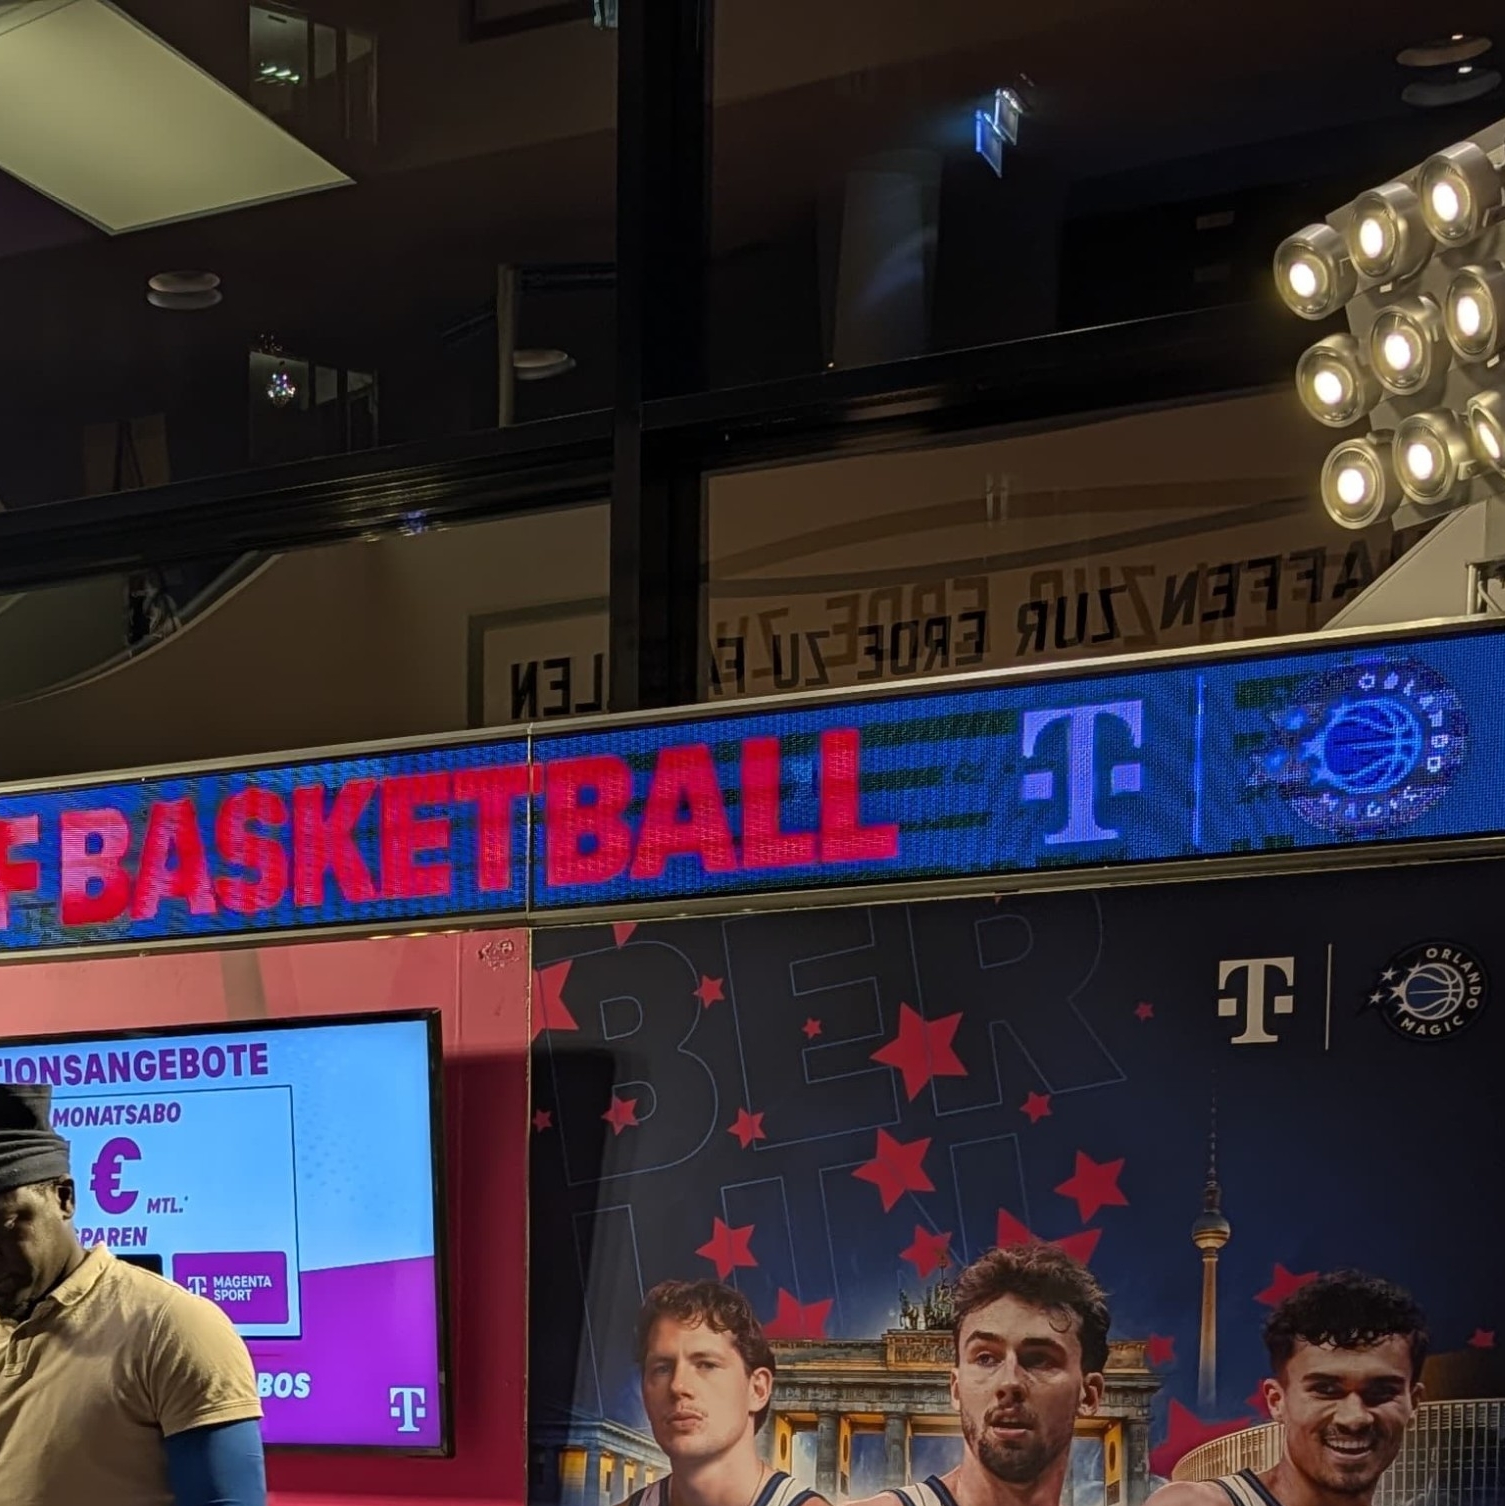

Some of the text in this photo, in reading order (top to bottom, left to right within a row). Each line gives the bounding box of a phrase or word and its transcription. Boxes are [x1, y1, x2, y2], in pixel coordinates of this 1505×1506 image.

[1022, 699, 1143, 846] T
[58, 726, 902, 927] BASKETBALL
[1217, 956, 1295, 1044] T
[1426, 947, 1483, 1010] ORLANDO
[1400, 1014, 1465, 1036] MAGIC
[52, 1101, 182, 1128] MONATSABO
[213, 1275, 273, 1289] MAGENTA
[213, 1289, 253, 1302] SPORT
[389, 1387, 427, 1432] T
